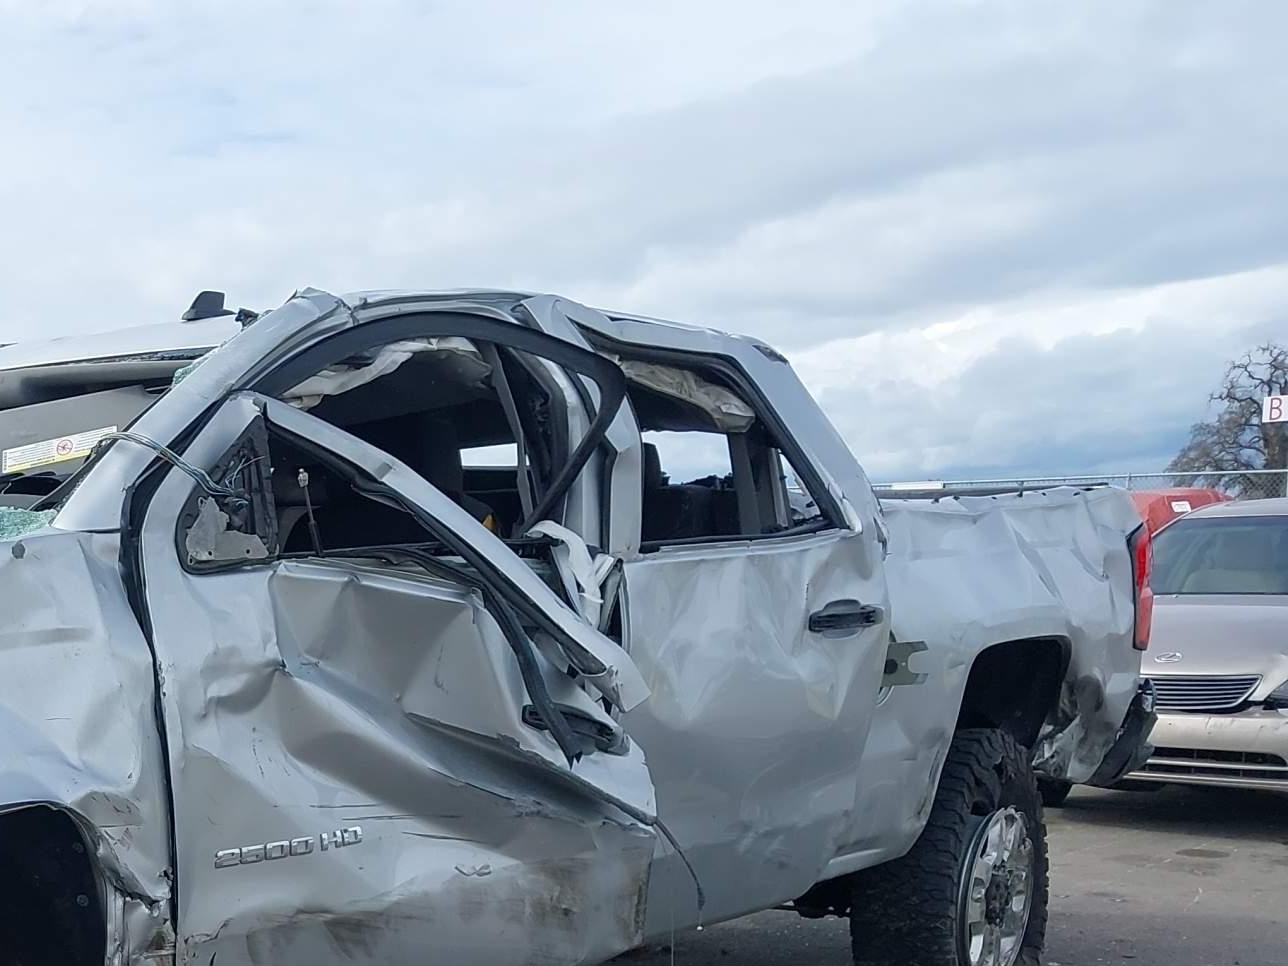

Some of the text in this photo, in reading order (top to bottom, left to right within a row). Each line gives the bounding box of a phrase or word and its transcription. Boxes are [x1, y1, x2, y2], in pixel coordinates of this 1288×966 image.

[1269, 397, 1282, 421] B
[214, 826, 362, 869] 2500 HD
